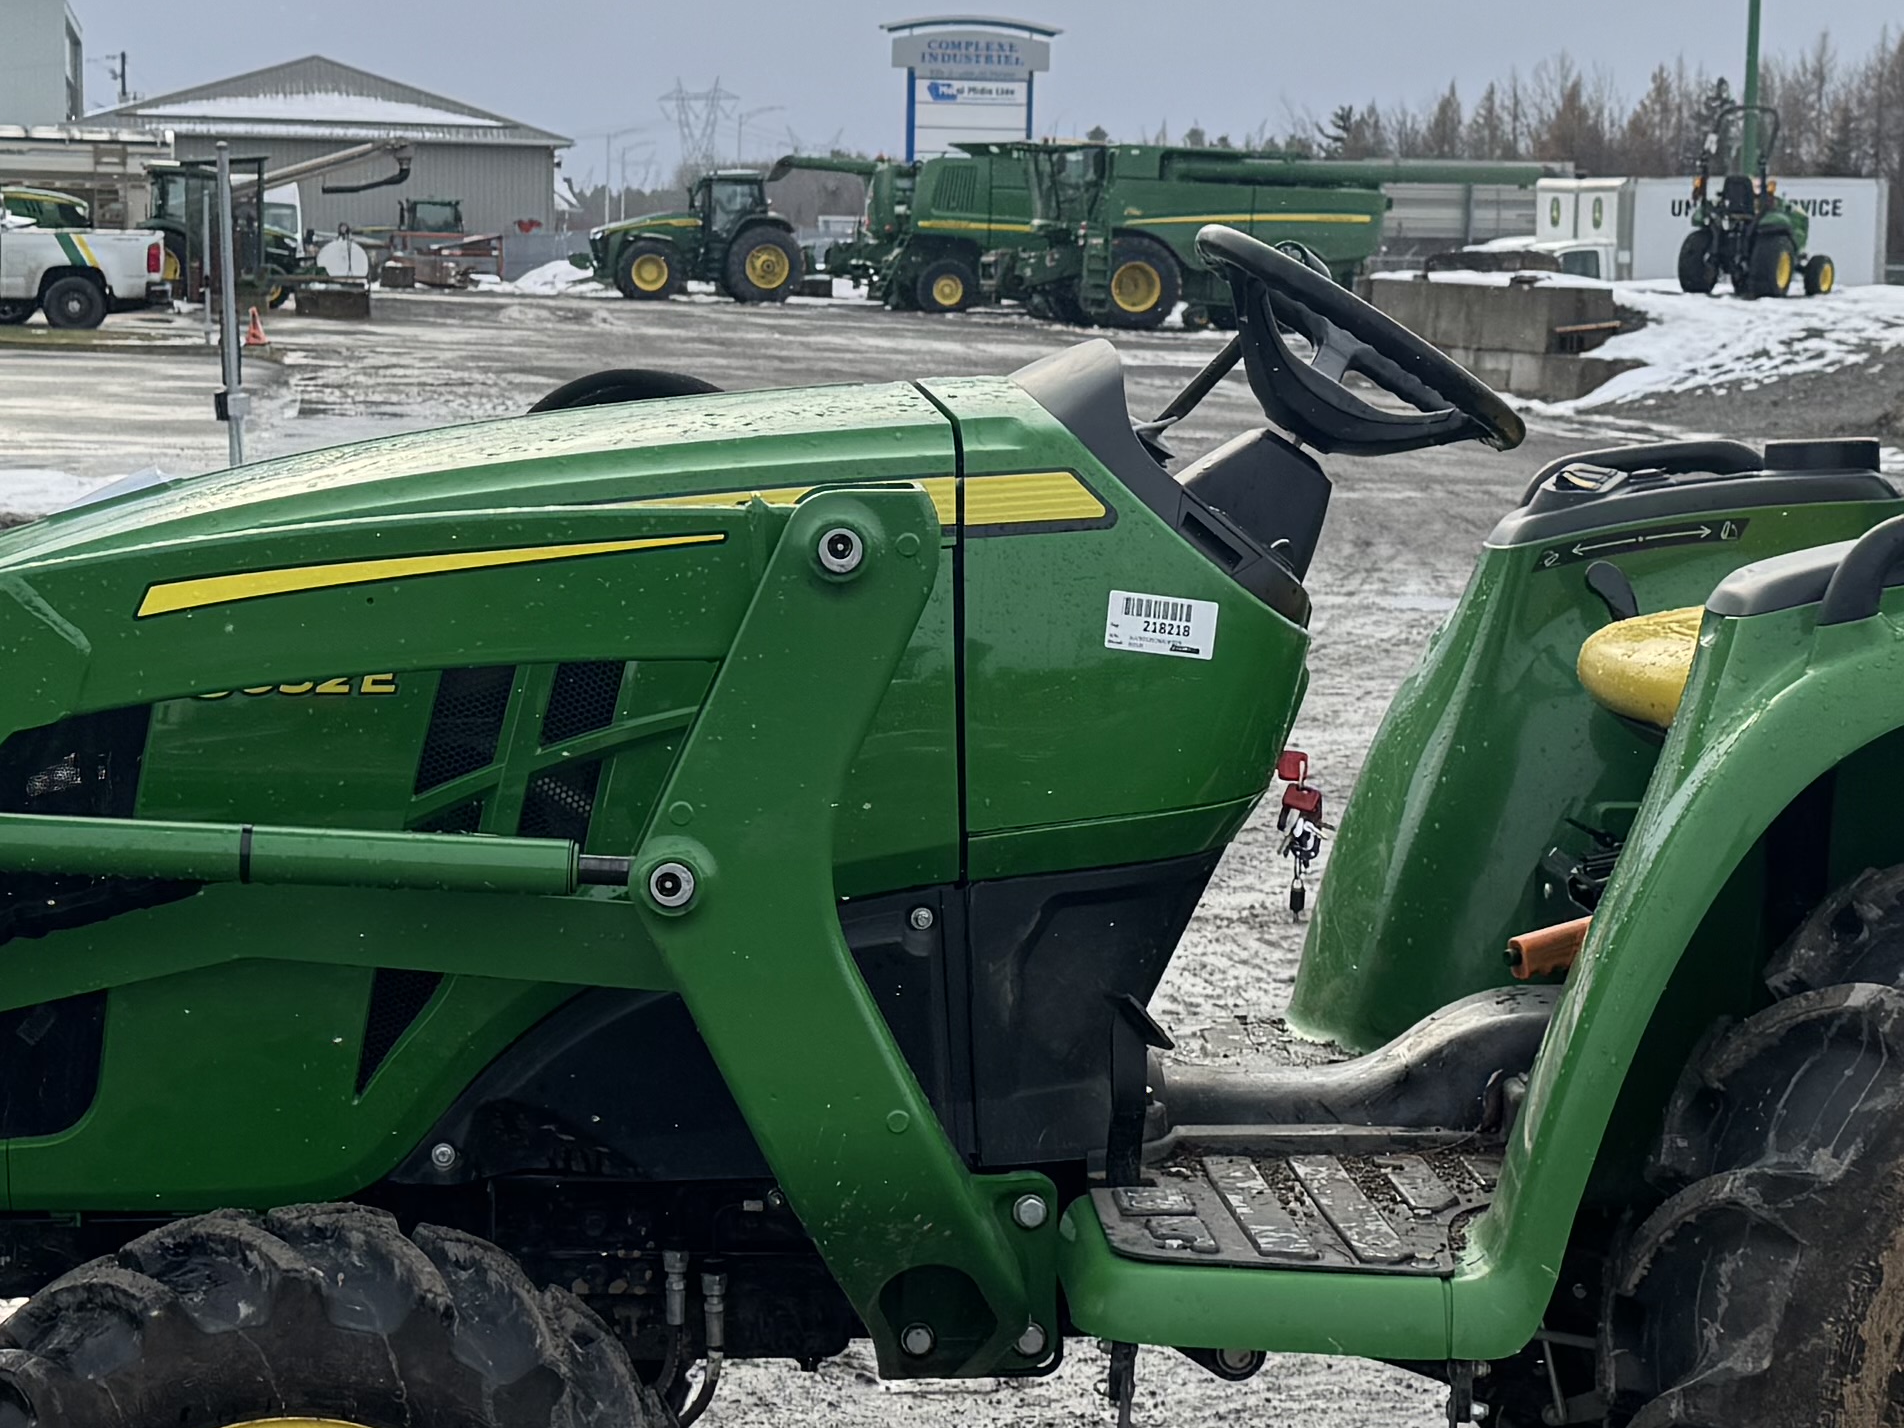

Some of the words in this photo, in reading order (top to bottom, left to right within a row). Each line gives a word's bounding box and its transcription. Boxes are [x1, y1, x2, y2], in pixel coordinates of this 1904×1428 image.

[927, 39, 1019, 53] COMPLEXE
[920, 52, 1025, 67] INDUSTRIEL
[1142, 620, 1191, 638] 218218
